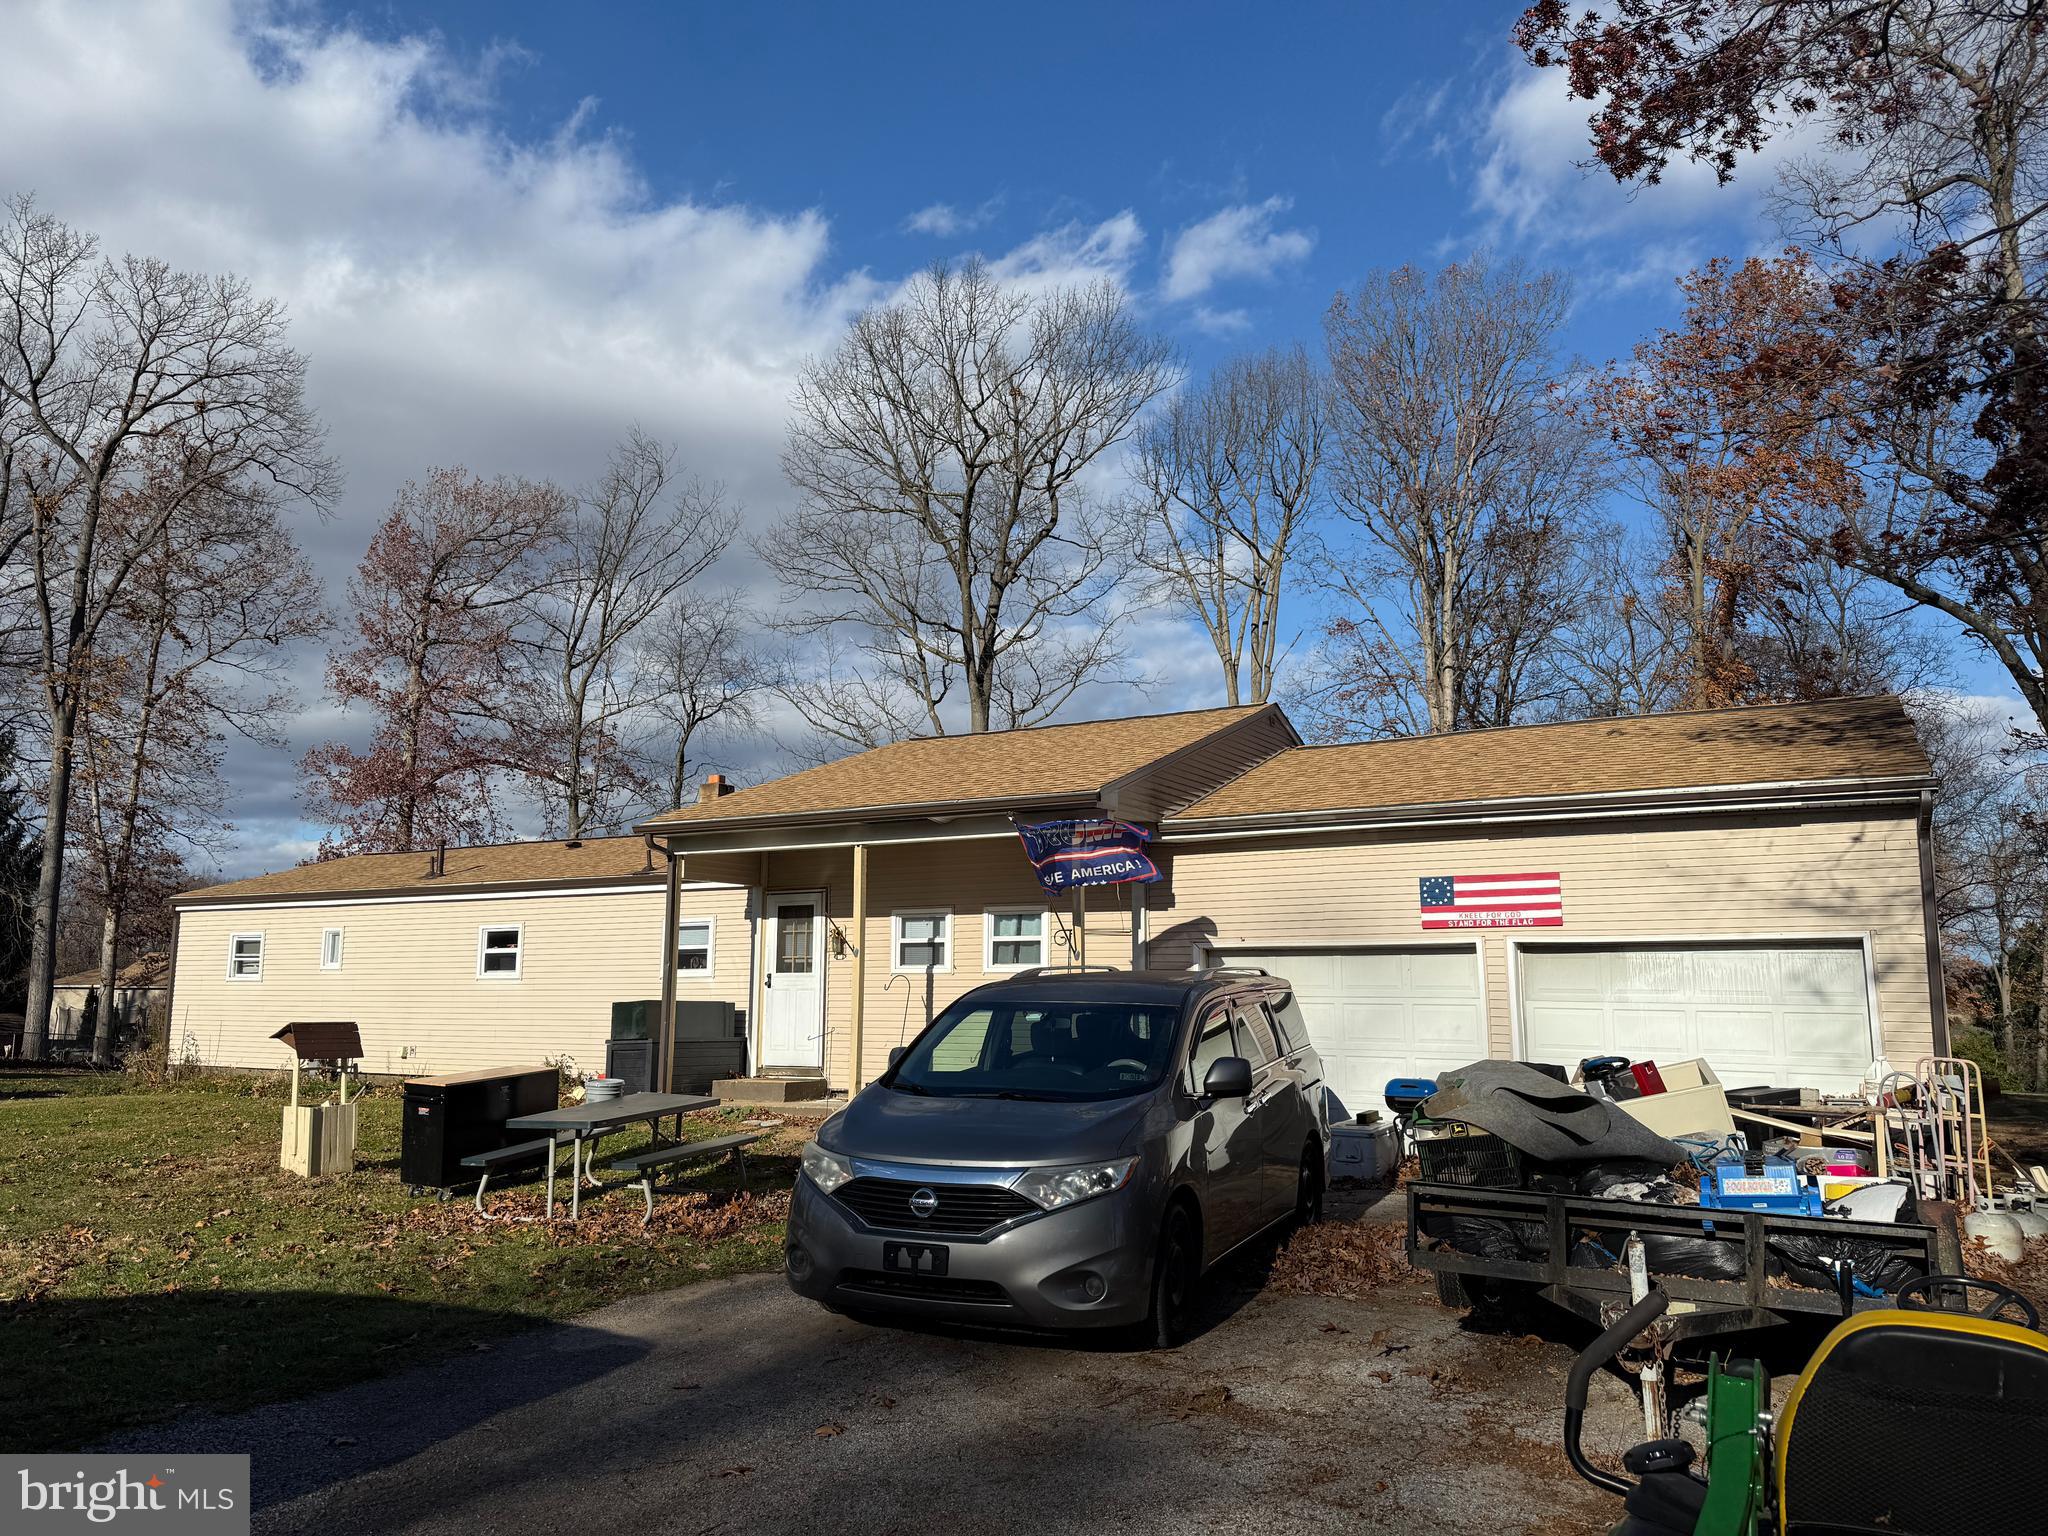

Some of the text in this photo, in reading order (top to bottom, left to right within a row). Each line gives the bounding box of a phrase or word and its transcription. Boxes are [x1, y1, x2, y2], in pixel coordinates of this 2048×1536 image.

[1447, 920, 1474, 928] STAND
[1476, 919, 1492, 927] FOR
[1512, 918, 1534, 926] FLAG
